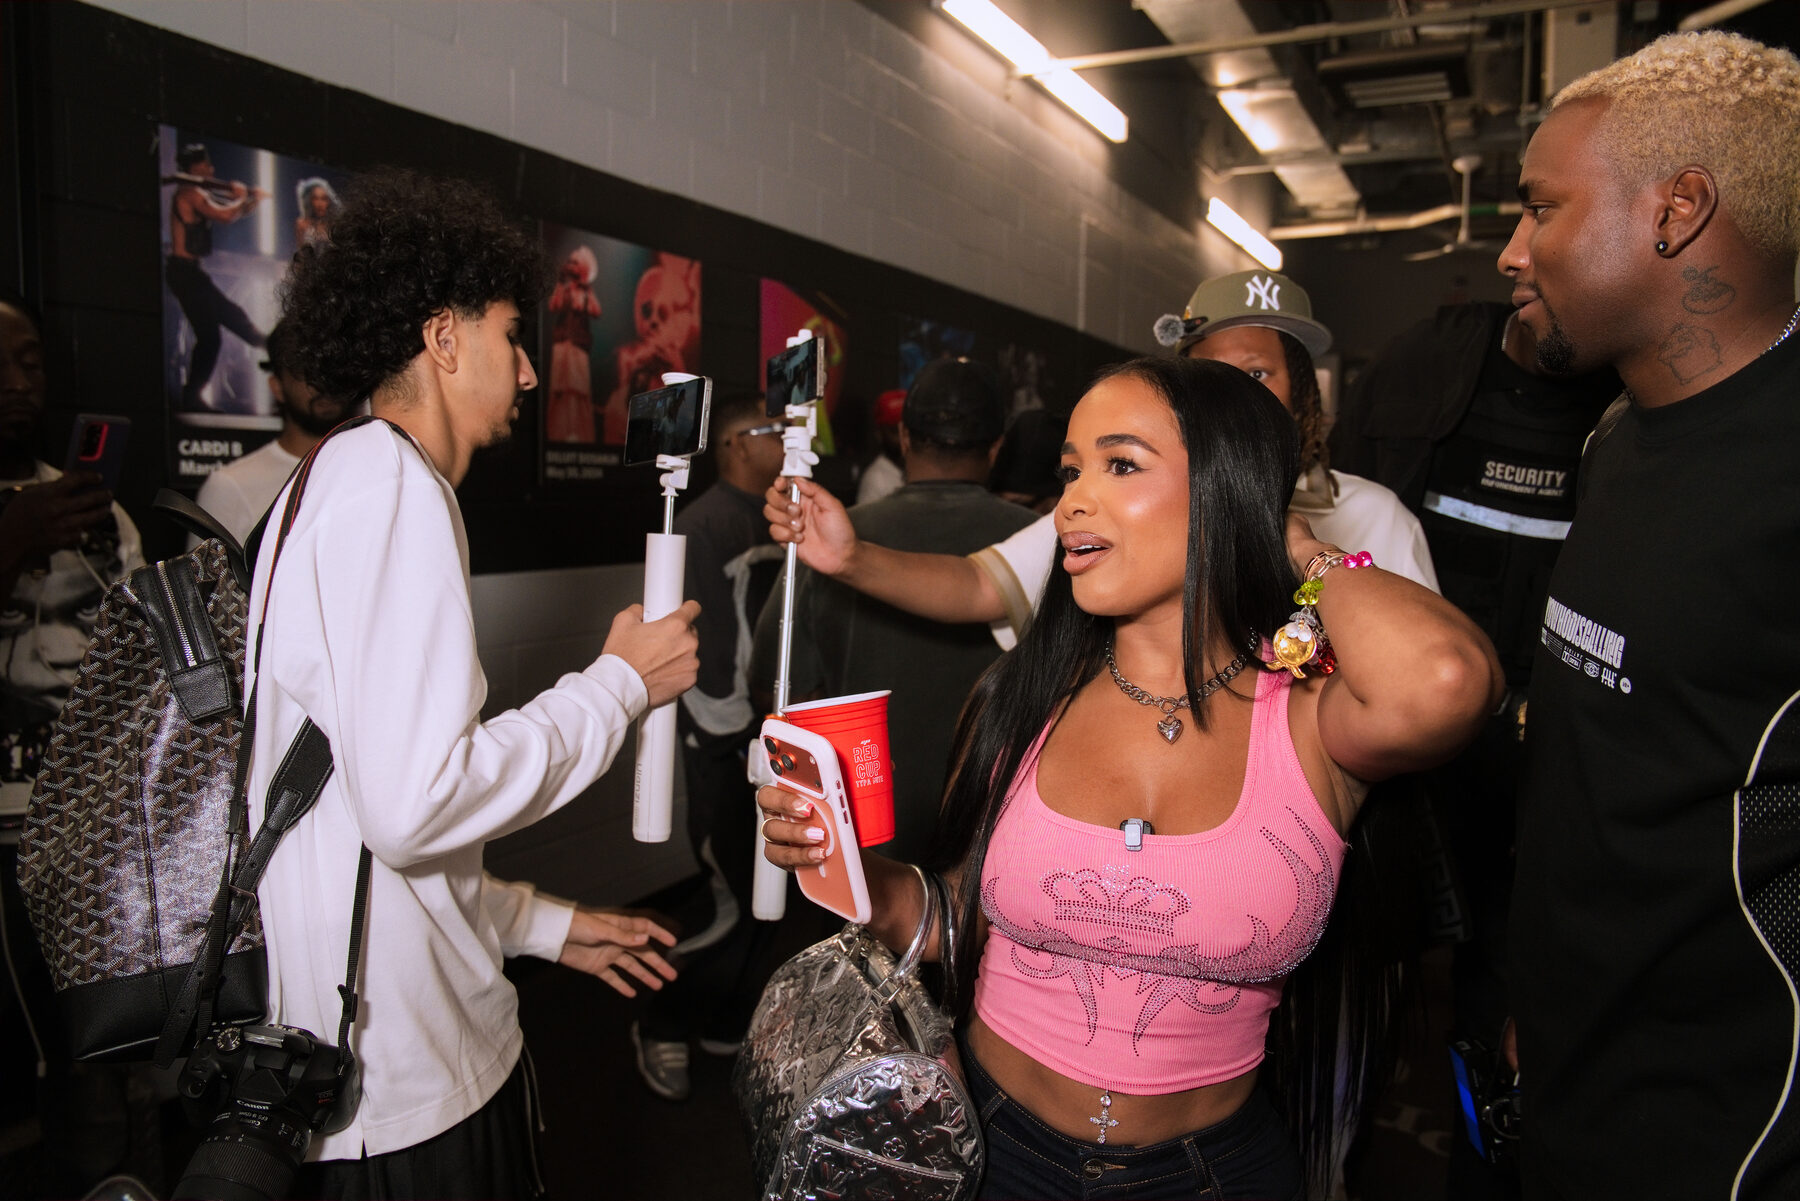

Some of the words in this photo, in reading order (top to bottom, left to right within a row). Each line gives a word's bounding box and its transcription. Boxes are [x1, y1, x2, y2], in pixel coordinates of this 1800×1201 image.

[1245, 275, 1280, 311] NY
[179, 439, 229, 456] CARDI
[231, 441, 243, 456] B
[1484, 460, 1566, 487] SECURITY
[853, 744, 880, 763] RED
[856, 760, 880, 779] CUP
[236, 1099, 269, 1110] Canon
